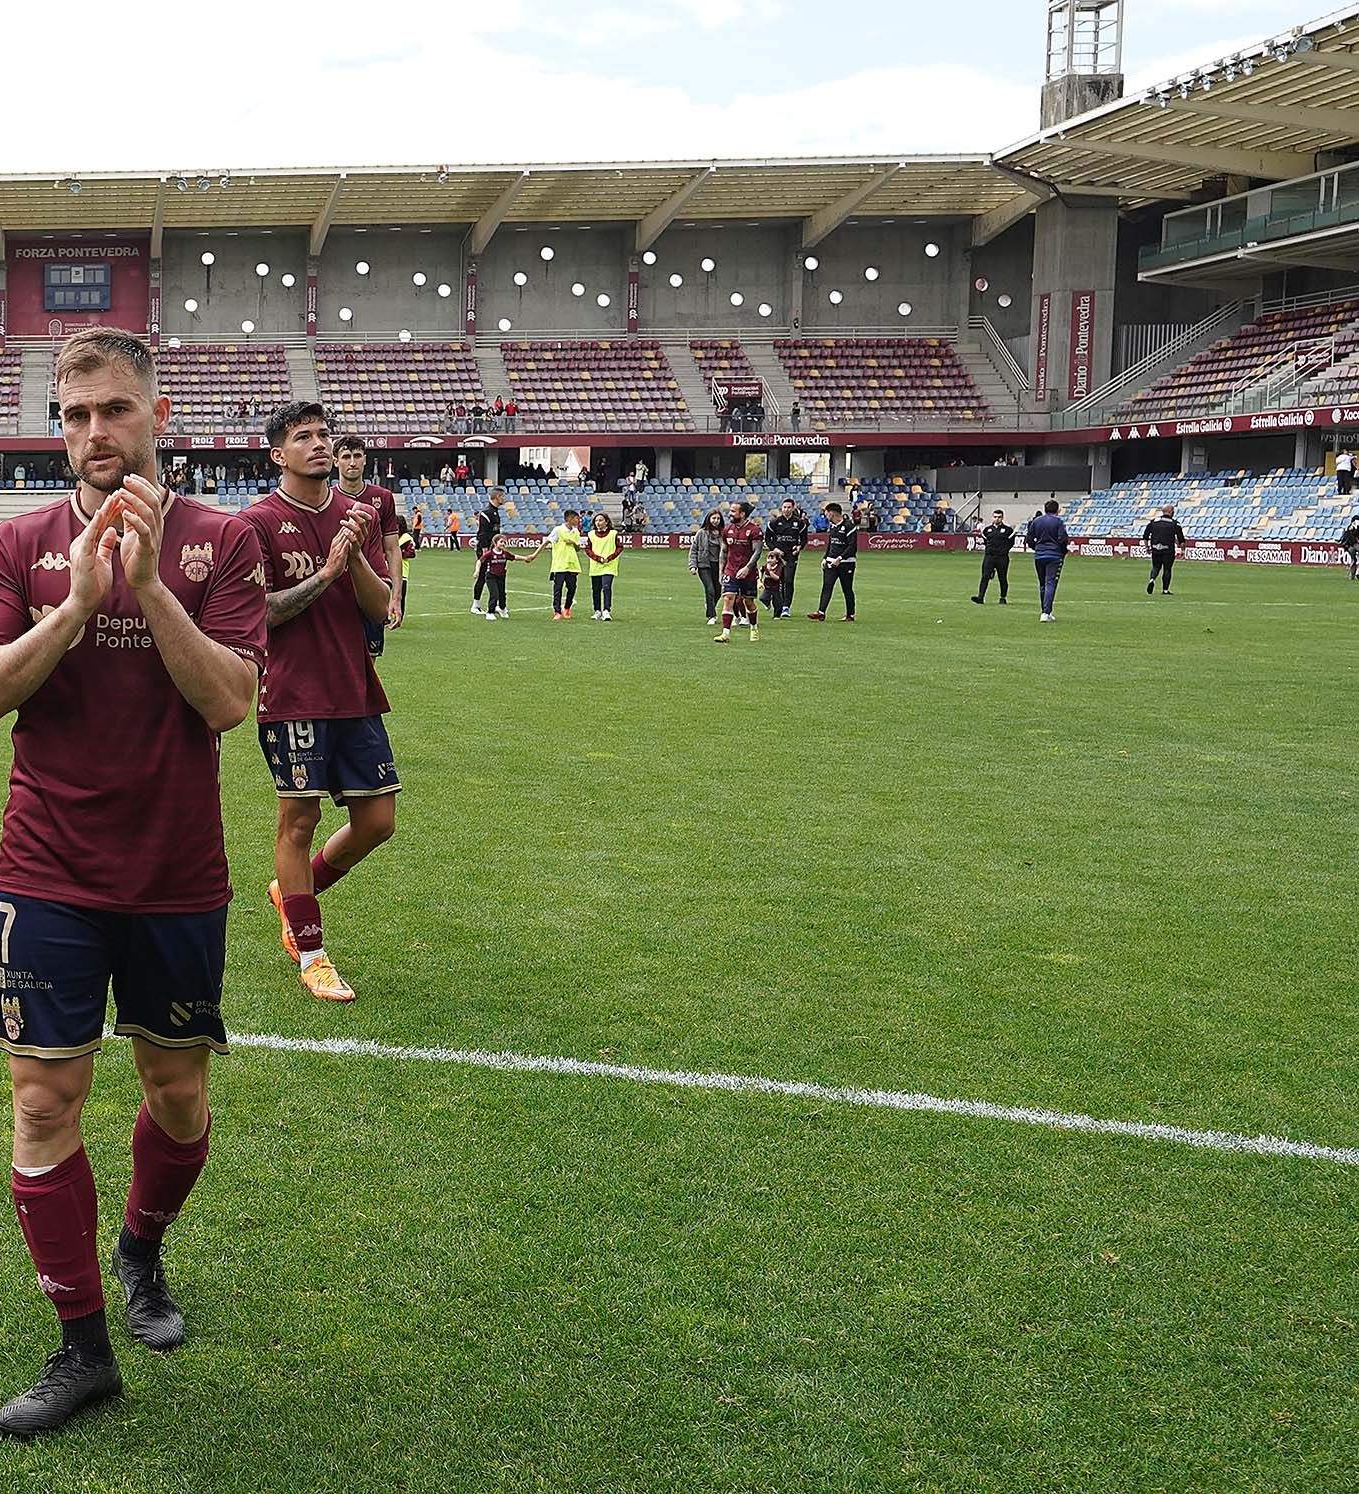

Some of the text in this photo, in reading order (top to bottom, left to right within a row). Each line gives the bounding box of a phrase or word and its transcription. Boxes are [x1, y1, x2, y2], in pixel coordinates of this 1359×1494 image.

[15, 247, 140, 258] FORZA PONTEVEDRA
[1039, 298, 1049, 357] Pontevedra
[1076, 295, 1091, 355] Pontevedra
[1073, 365, 1088, 398] Diario
[1175, 419, 1223, 434] Estrella Galicia
[1250, 412, 1304, 429] Estrella Galicia
[192, 437, 215, 445] FROIZ
[225, 436, 249, 445] FROIZ
[733, 434, 763, 446] Diario
[773, 434, 830, 446] Pontevedra
[642, 534, 670, 544] FROIZ
[1080, 544, 1114, 556] PESCAMAR
[1185, 547, 1225, 560] PESCAMAR
[1247, 549, 1292, 563] PESCAMAR
[1301, 545, 1329, 564] Diario
[284, 720, 315, 750] 19
[6, 971, 34, 980] XUNTA
[6, 980, 54, 990] DE GALICIA
